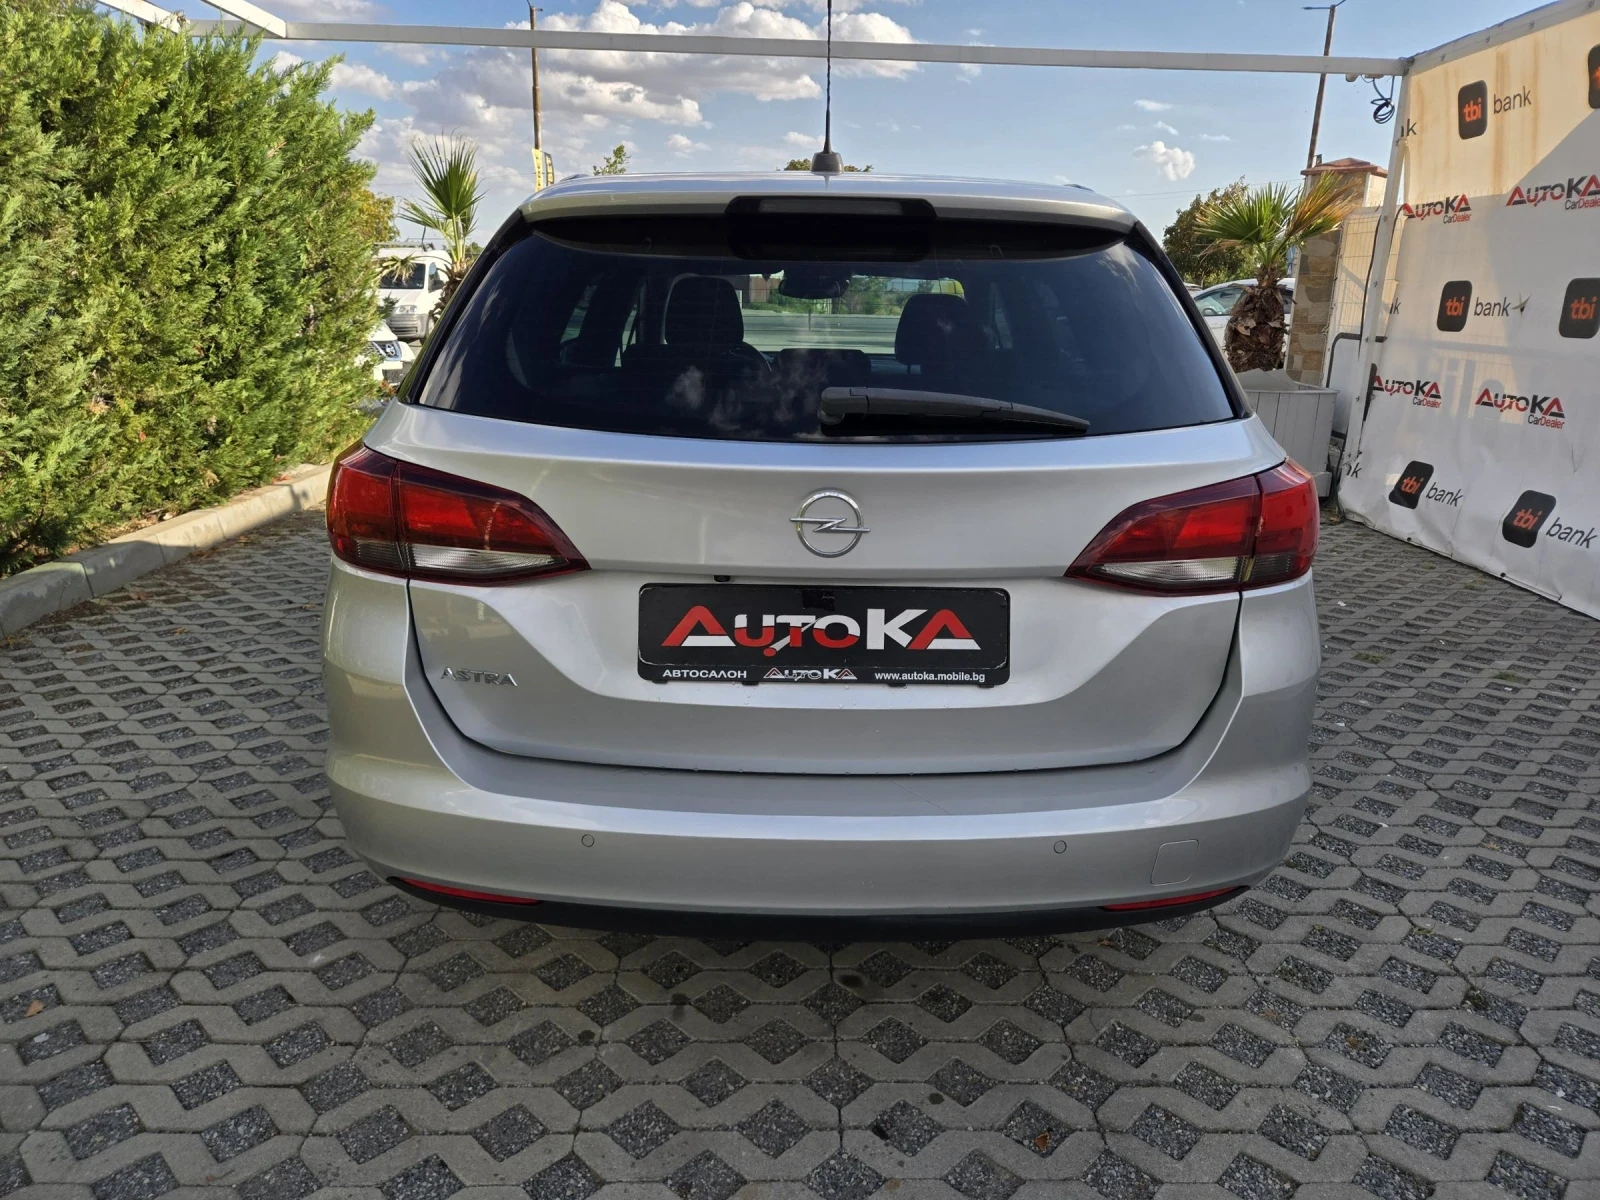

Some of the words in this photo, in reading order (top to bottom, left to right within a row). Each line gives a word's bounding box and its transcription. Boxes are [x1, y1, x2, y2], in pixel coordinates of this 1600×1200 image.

[1463, 97, 1482, 122] tbi
[1493, 86, 1532, 114] bank
[1445, 296, 1466, 316] tbi
[1474, 297, 1512, 317] bank
[1570, 296, 1598, 320] tbi
[1401, 476, 1424, 495] tbi
[1426, 482, 1464, 507] bank
[1513, 508, 1543, 531] tbi
[1546, 517, 1599, 549] bank
[440, 667, 518, 687] ASTRA
[662, 669, 747, 679] АВТОСАЛОН
[874, 671, 986, 683] www.autoka.mobile.bg
